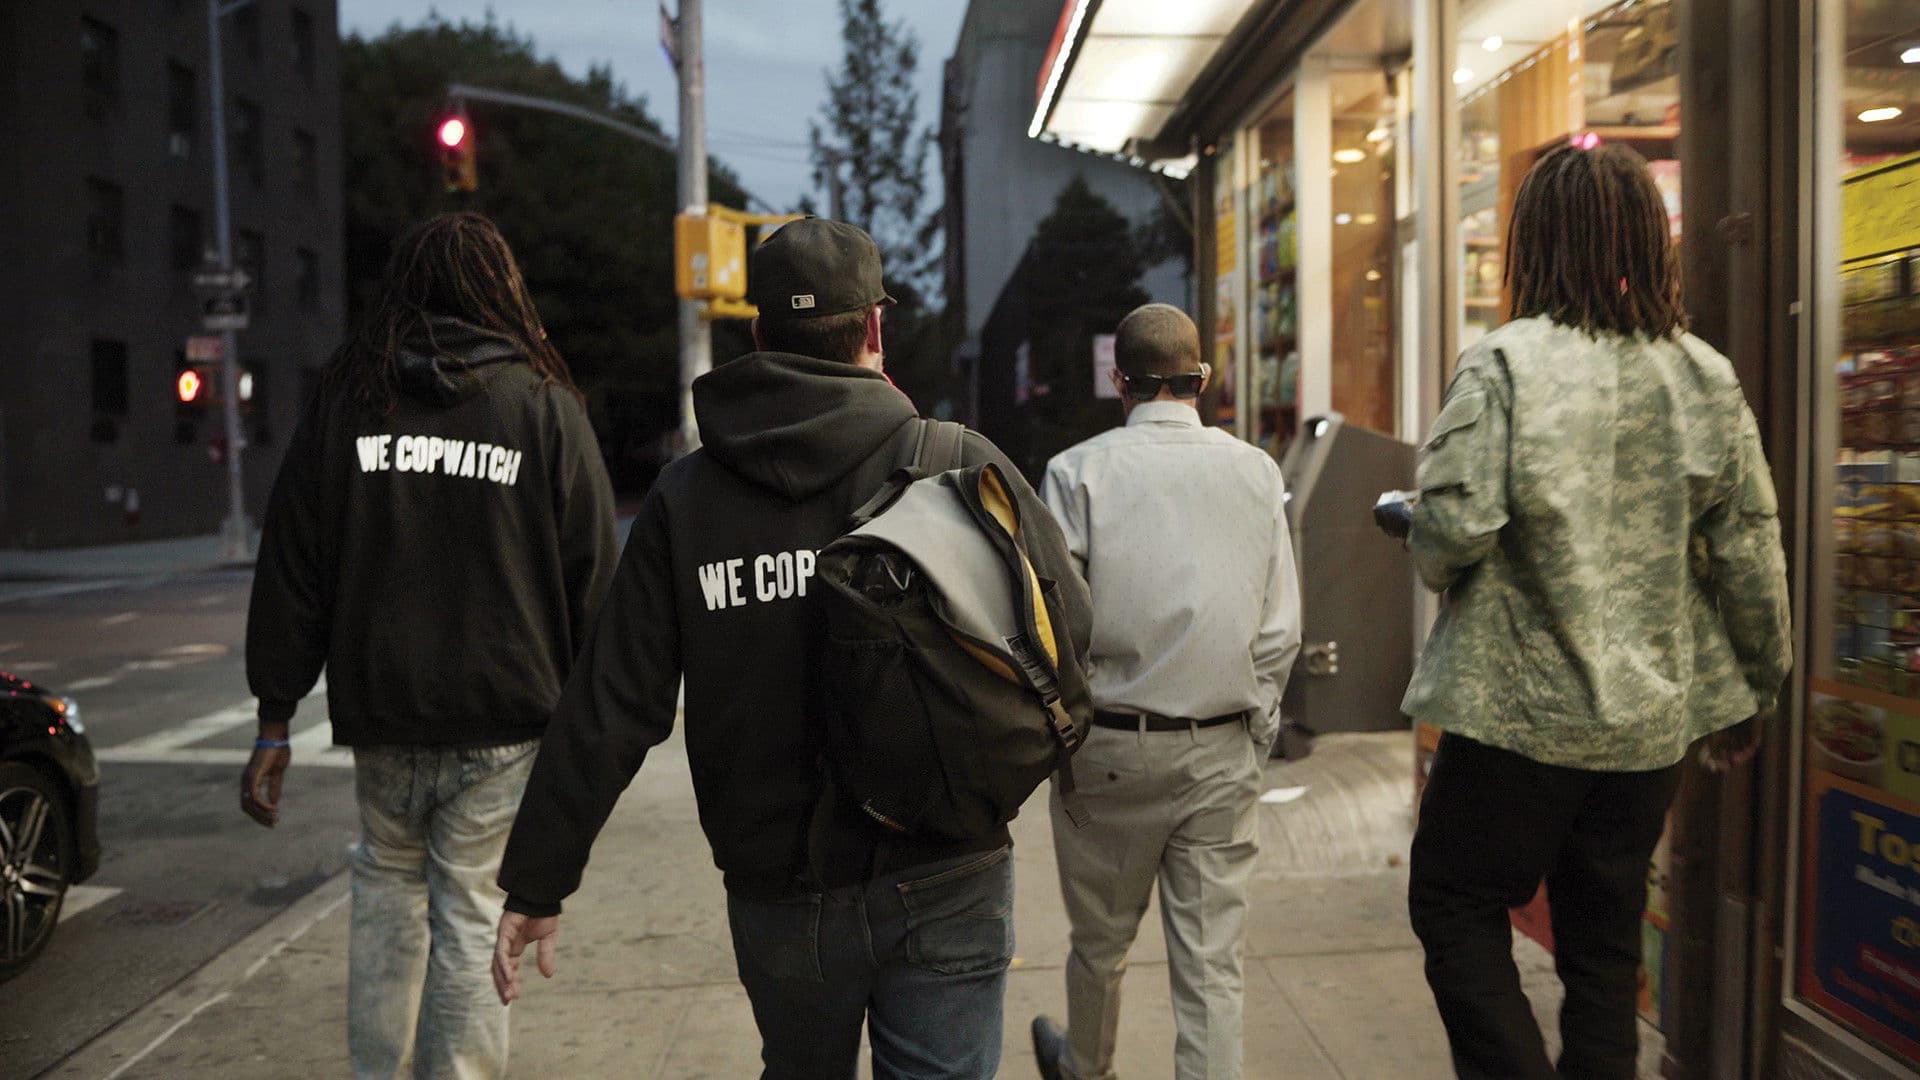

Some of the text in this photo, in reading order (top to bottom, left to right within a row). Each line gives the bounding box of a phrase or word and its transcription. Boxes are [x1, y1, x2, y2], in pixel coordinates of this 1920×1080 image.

[356, 434, 522, 486] WE COPWATCH
[698, 549, 822, 611] WE COP
